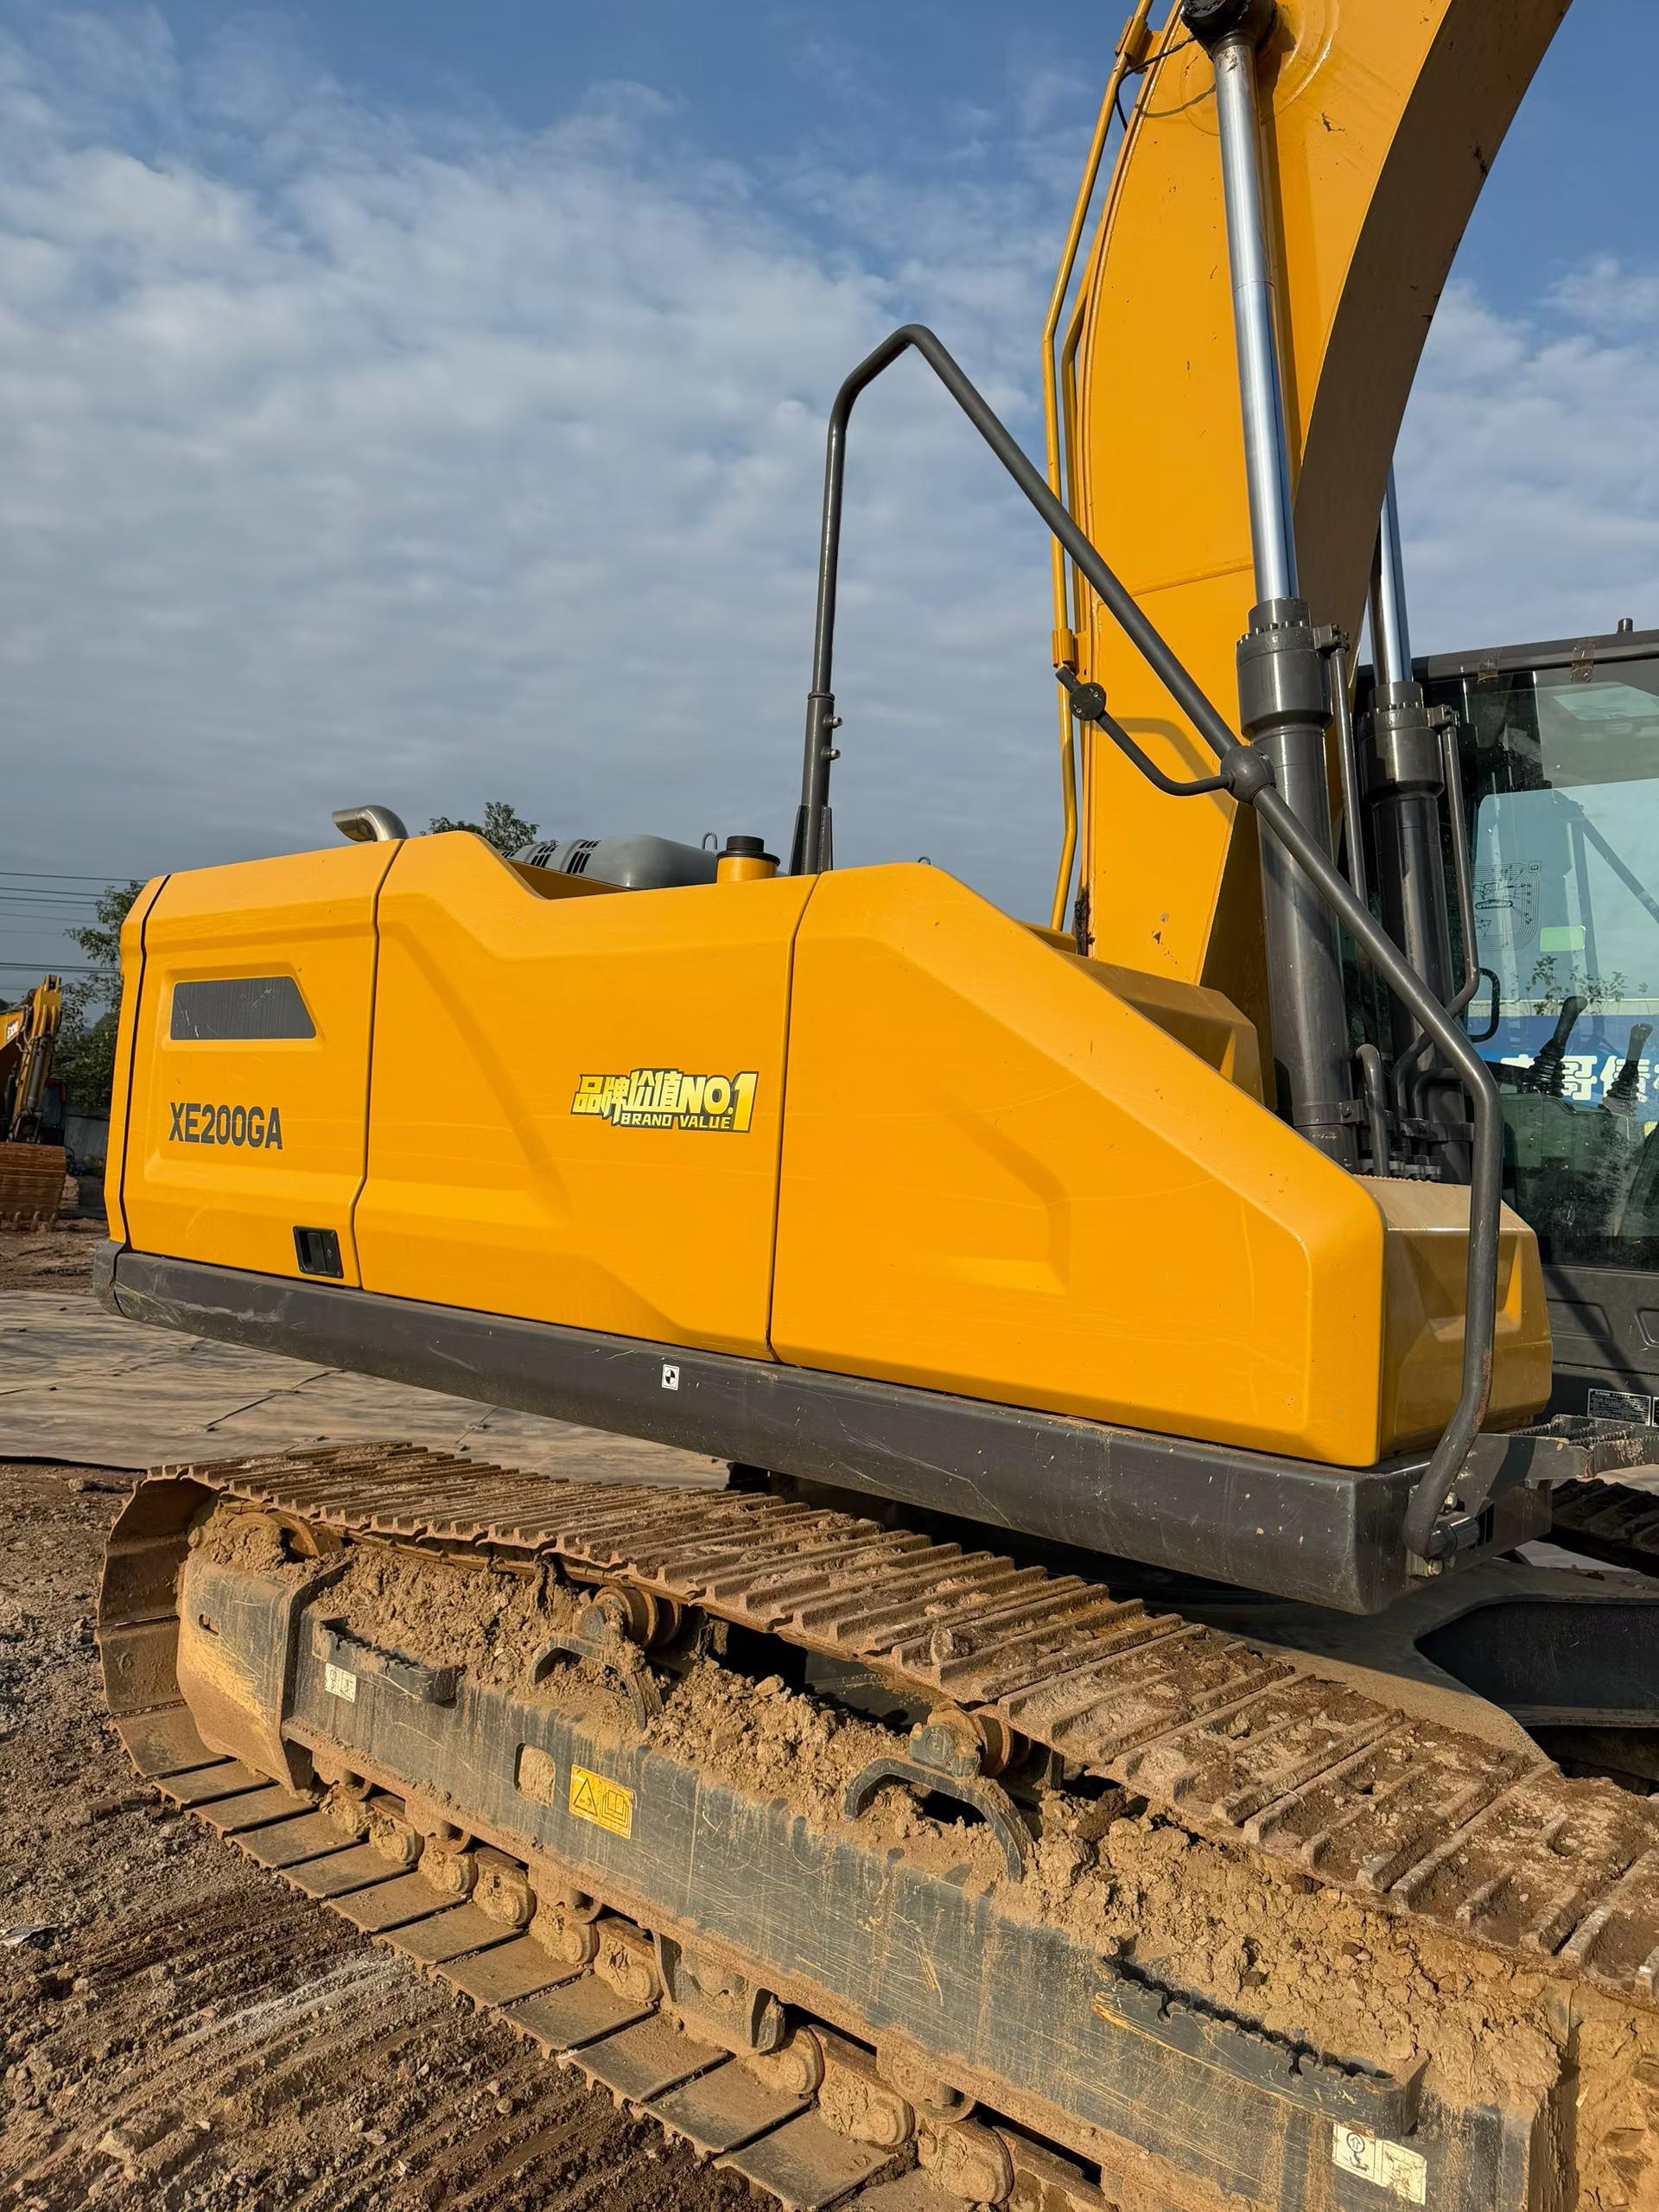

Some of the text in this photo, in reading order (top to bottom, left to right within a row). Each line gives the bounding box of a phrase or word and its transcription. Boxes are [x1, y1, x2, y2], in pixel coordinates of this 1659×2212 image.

[168, 1102, 283, 1149] XE200GA
[620, 1113, 731, 1129] BRAND VALUE
